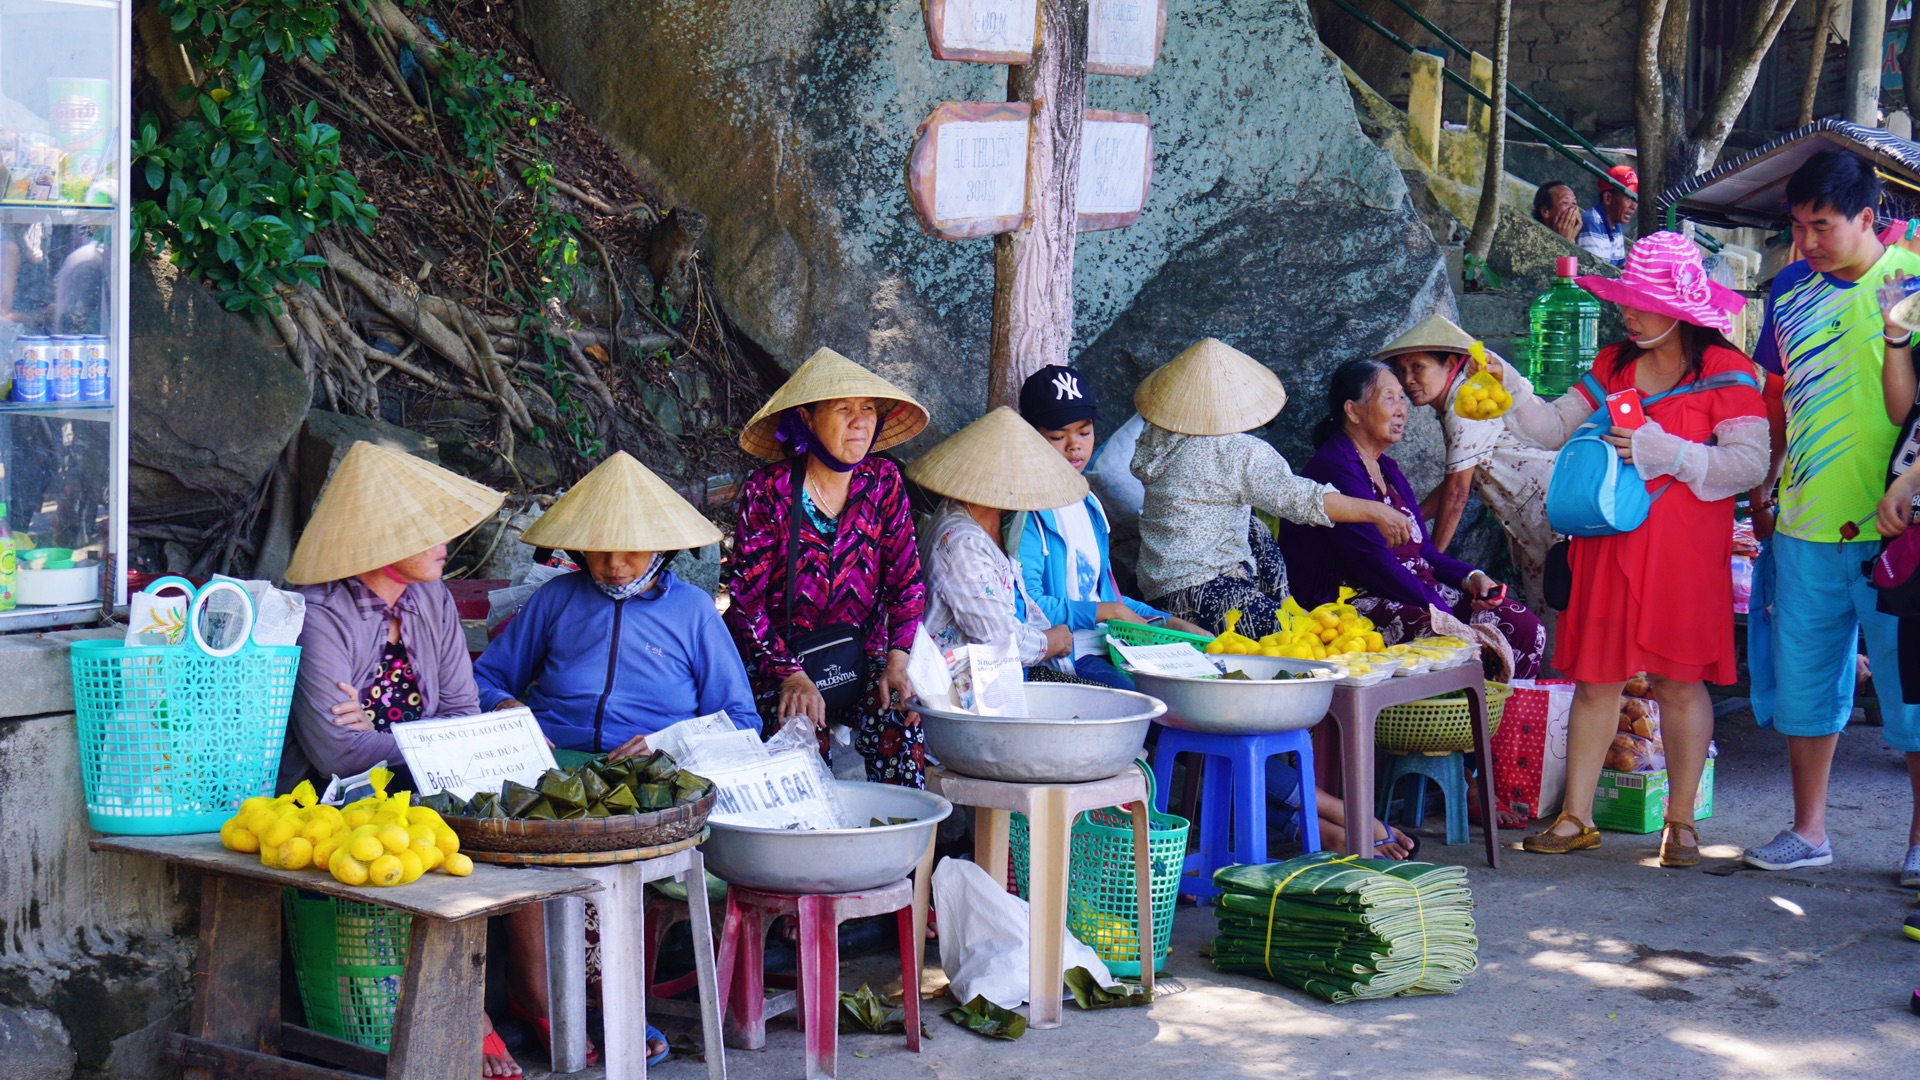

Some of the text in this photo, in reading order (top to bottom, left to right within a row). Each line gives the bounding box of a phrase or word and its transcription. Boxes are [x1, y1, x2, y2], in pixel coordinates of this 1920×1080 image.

[16, 364, 48, 382] Tiger
[1051, 372, 1083, 400] NY
[815, 670, 858, 689] PRUDENTIAL
[472, 724, 492, 737] LAO
[493, 719, 524, 733] CHÀM
[473, 749, 497, 761] SUSE
[492, 764, 506, 776] LÁ
[506, 762, 525, 773] GAI
[427, 768, 464, 790] Bánh
[733, 778, 758, 812] ÍT
[753, 772, 785, 809] LÁ
[780, 770, 817, 804] GAI
